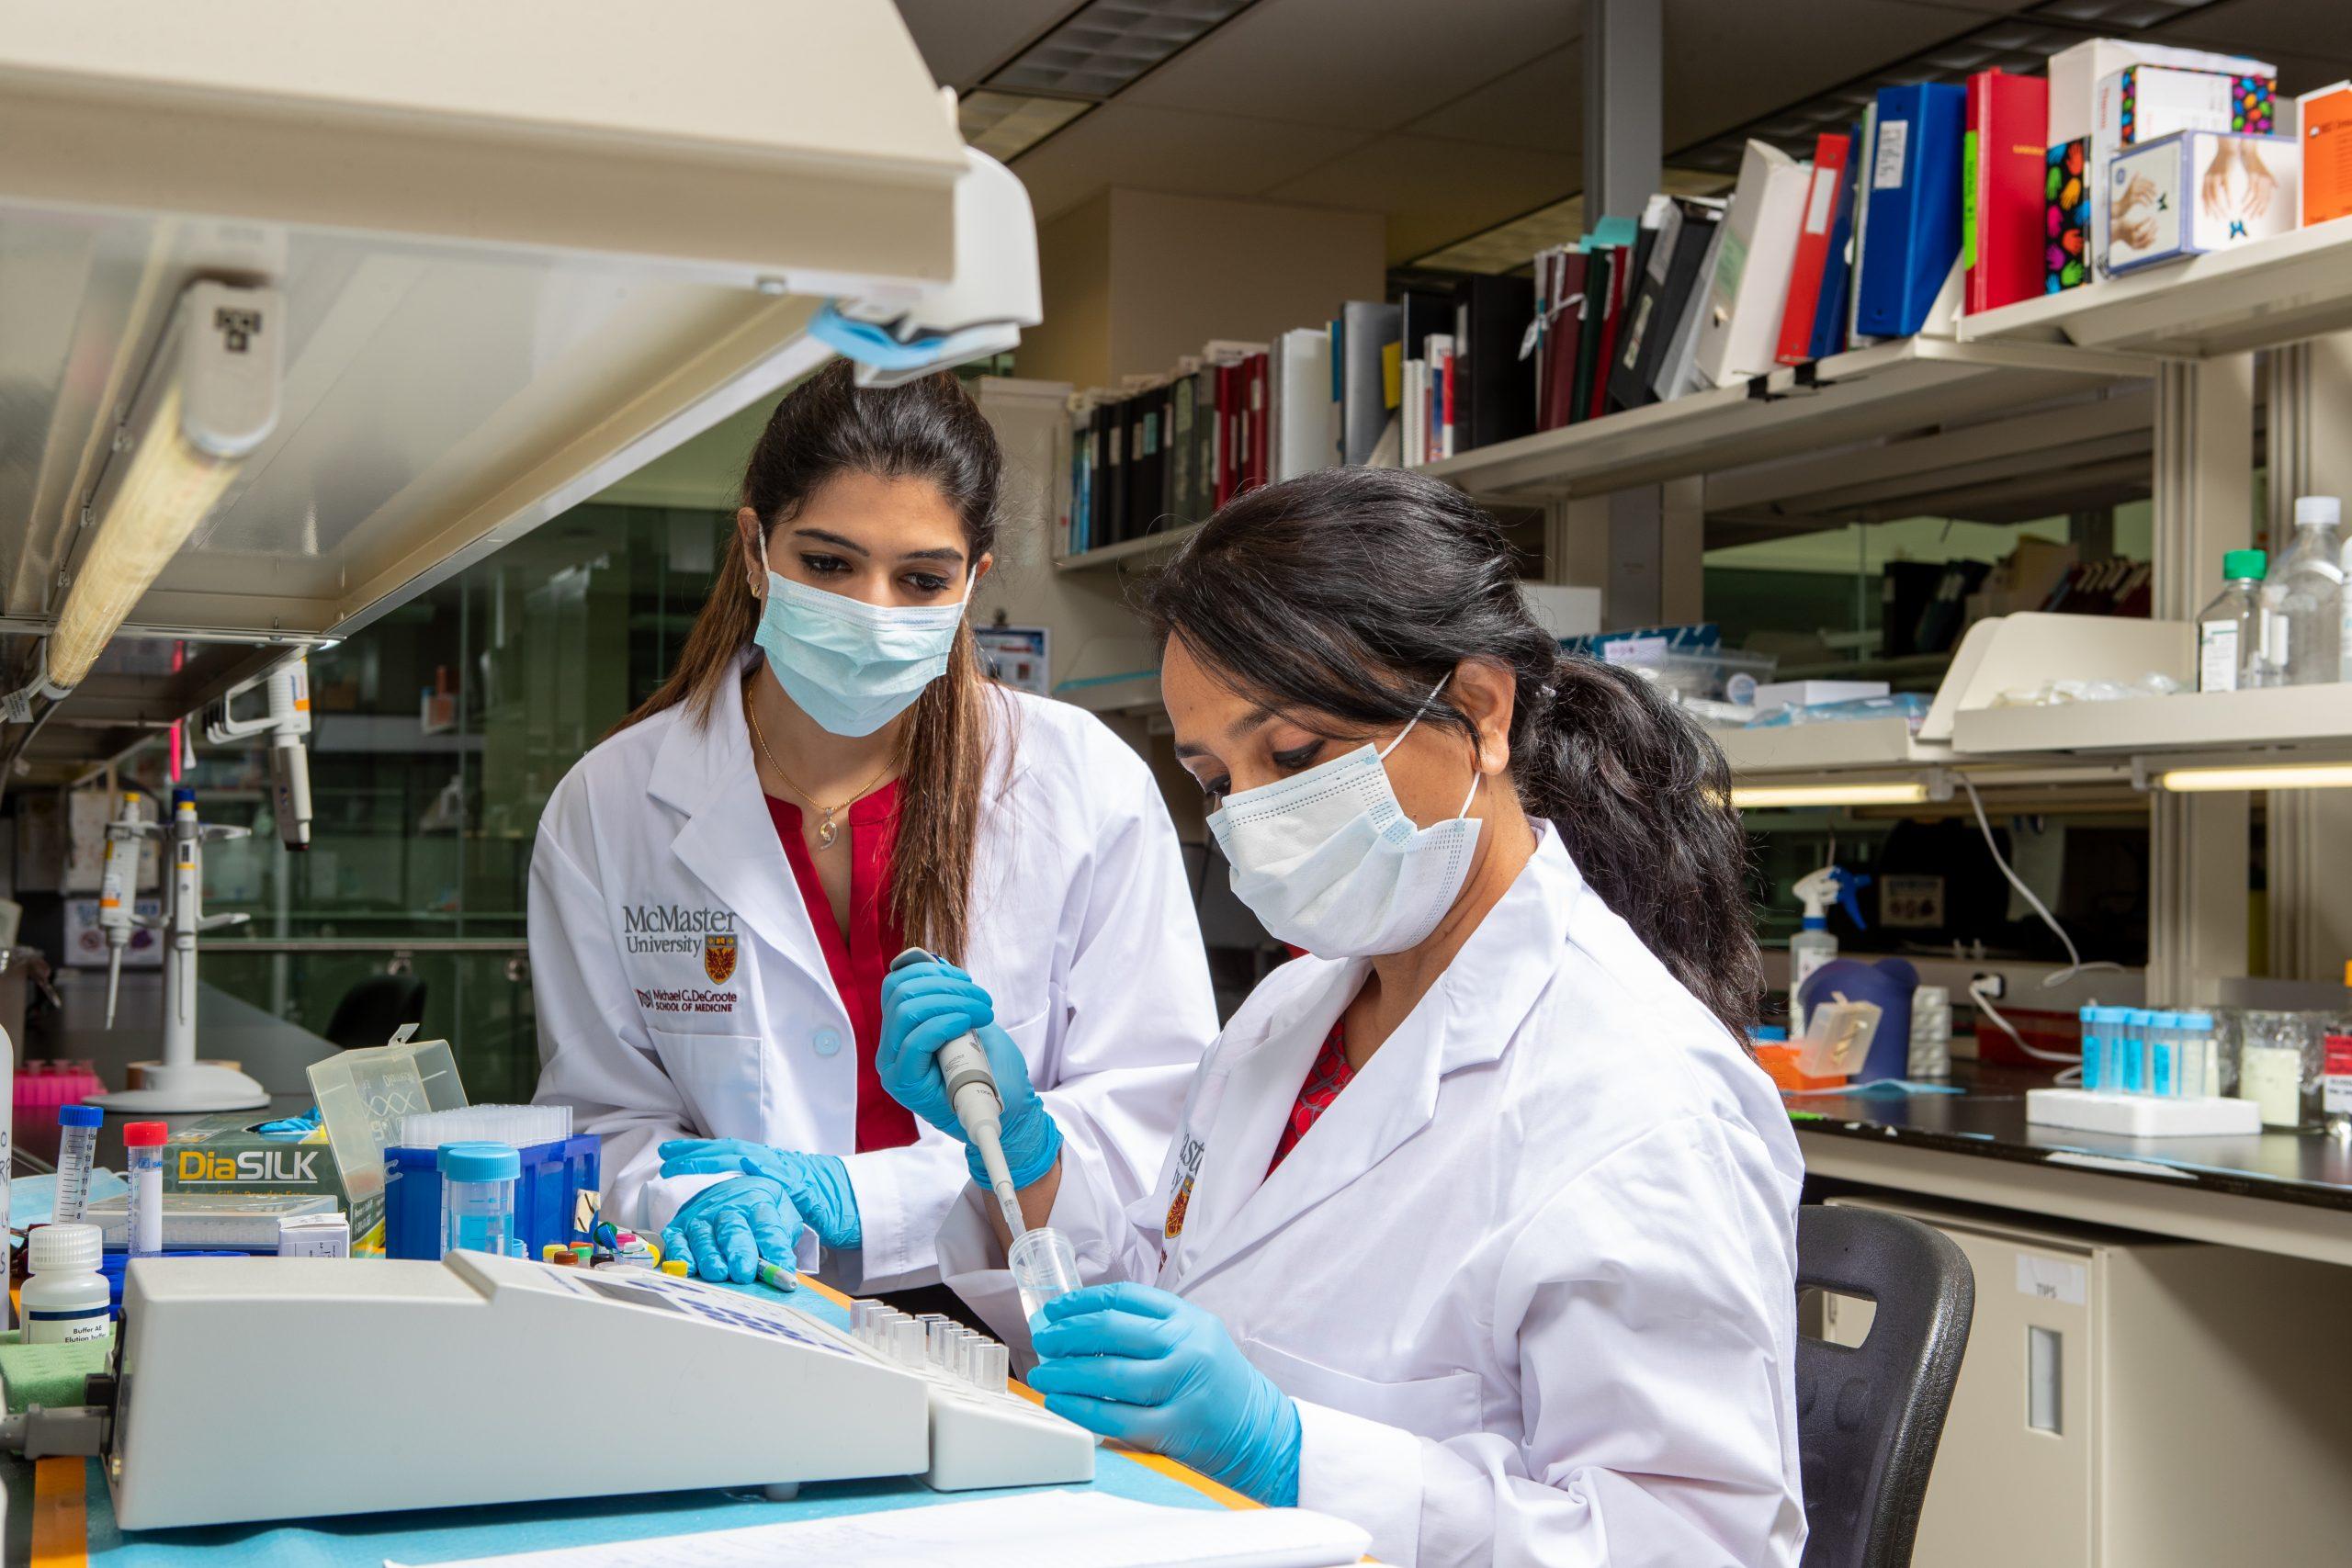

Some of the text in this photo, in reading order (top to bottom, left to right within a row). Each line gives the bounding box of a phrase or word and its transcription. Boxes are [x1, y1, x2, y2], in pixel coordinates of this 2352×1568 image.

[623, 905, 737, 933] McMaster
[626, 935, 702, 958] University
[652, 989, 681, 1002] Michael
[692, 989, 737, 1002] DeGroote
[655, 1002, 733, 1012] SCHOOL OF MEDICINE
[178, 1151, 319, 1180] DiaSILK
[76, 1212, 81, 1220] 8
